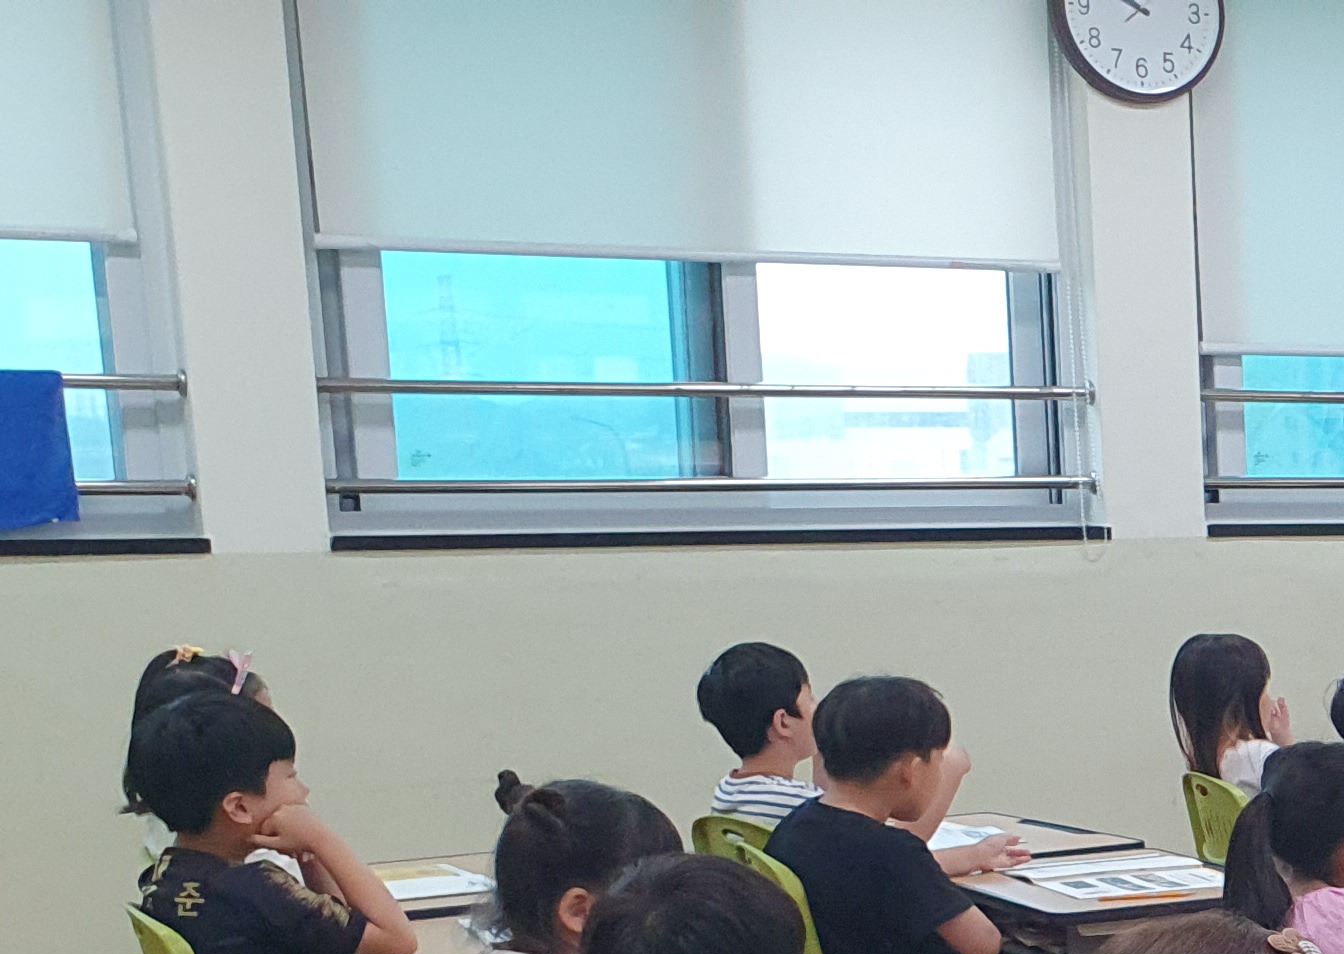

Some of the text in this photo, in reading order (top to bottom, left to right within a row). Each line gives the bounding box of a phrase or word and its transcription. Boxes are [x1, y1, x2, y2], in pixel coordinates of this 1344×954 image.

[1078, 0, 1090, 15] 9
[1187, 2, 1201, 25] 3
[1088, 26, 1101, 48] 8
[1179, 32, 1193, 54] 4
[1111, 47, 1123, 69] 7
[1135, 57, 1149, 79] 6
[1162, 51, 1175, 74] 5
[174, 881, 205, 917] 준
